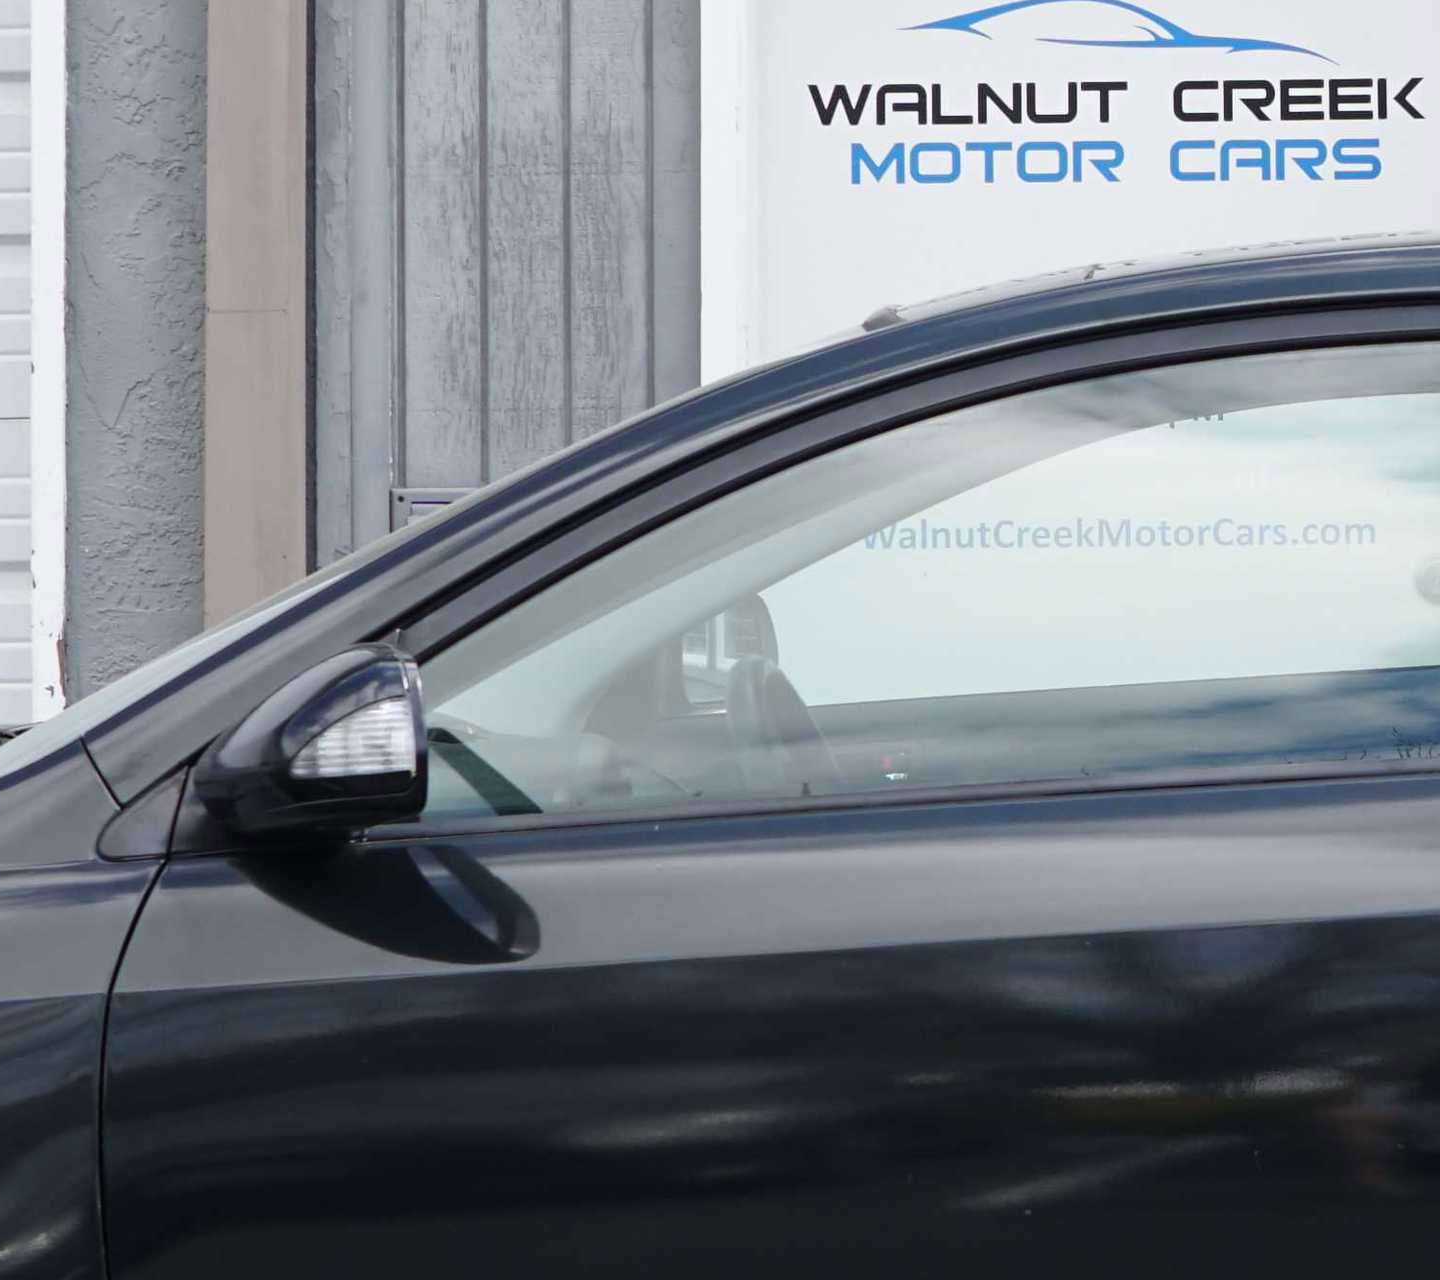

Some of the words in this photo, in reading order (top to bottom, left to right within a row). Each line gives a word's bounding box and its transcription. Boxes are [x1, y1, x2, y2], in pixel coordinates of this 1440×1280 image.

[807, 81, 1128, 126] WALNUT
[1173, 77, 1425, 122] CREEK
[851, 140, 1125, 185] MOTOR
[1170, 138, 1382, 181] CARS
